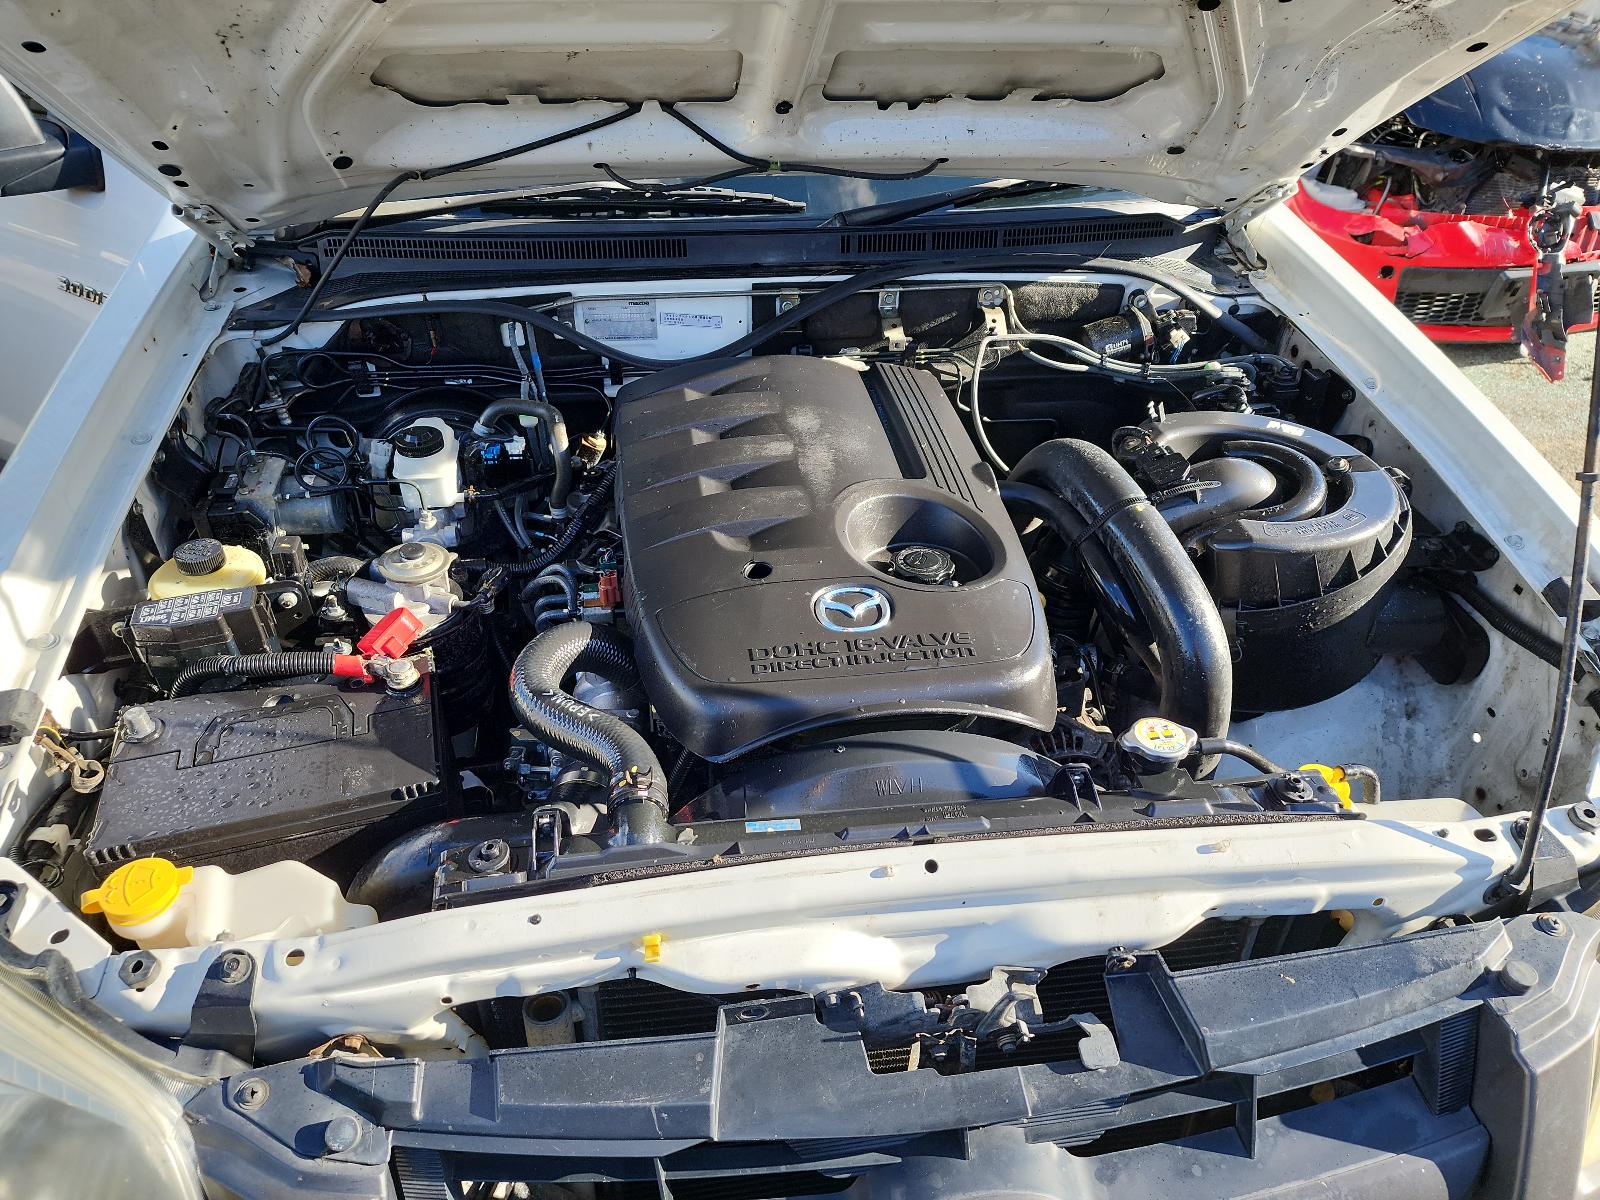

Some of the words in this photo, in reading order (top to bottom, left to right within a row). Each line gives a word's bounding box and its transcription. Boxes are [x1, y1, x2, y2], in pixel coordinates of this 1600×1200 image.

[747, 640, 840, 662] DOHC
[843, 632, 974, 653] 16-VALVE
[750, 656, 844, 675] DIRECT
[845, 646, 977, 666] INJECTION
